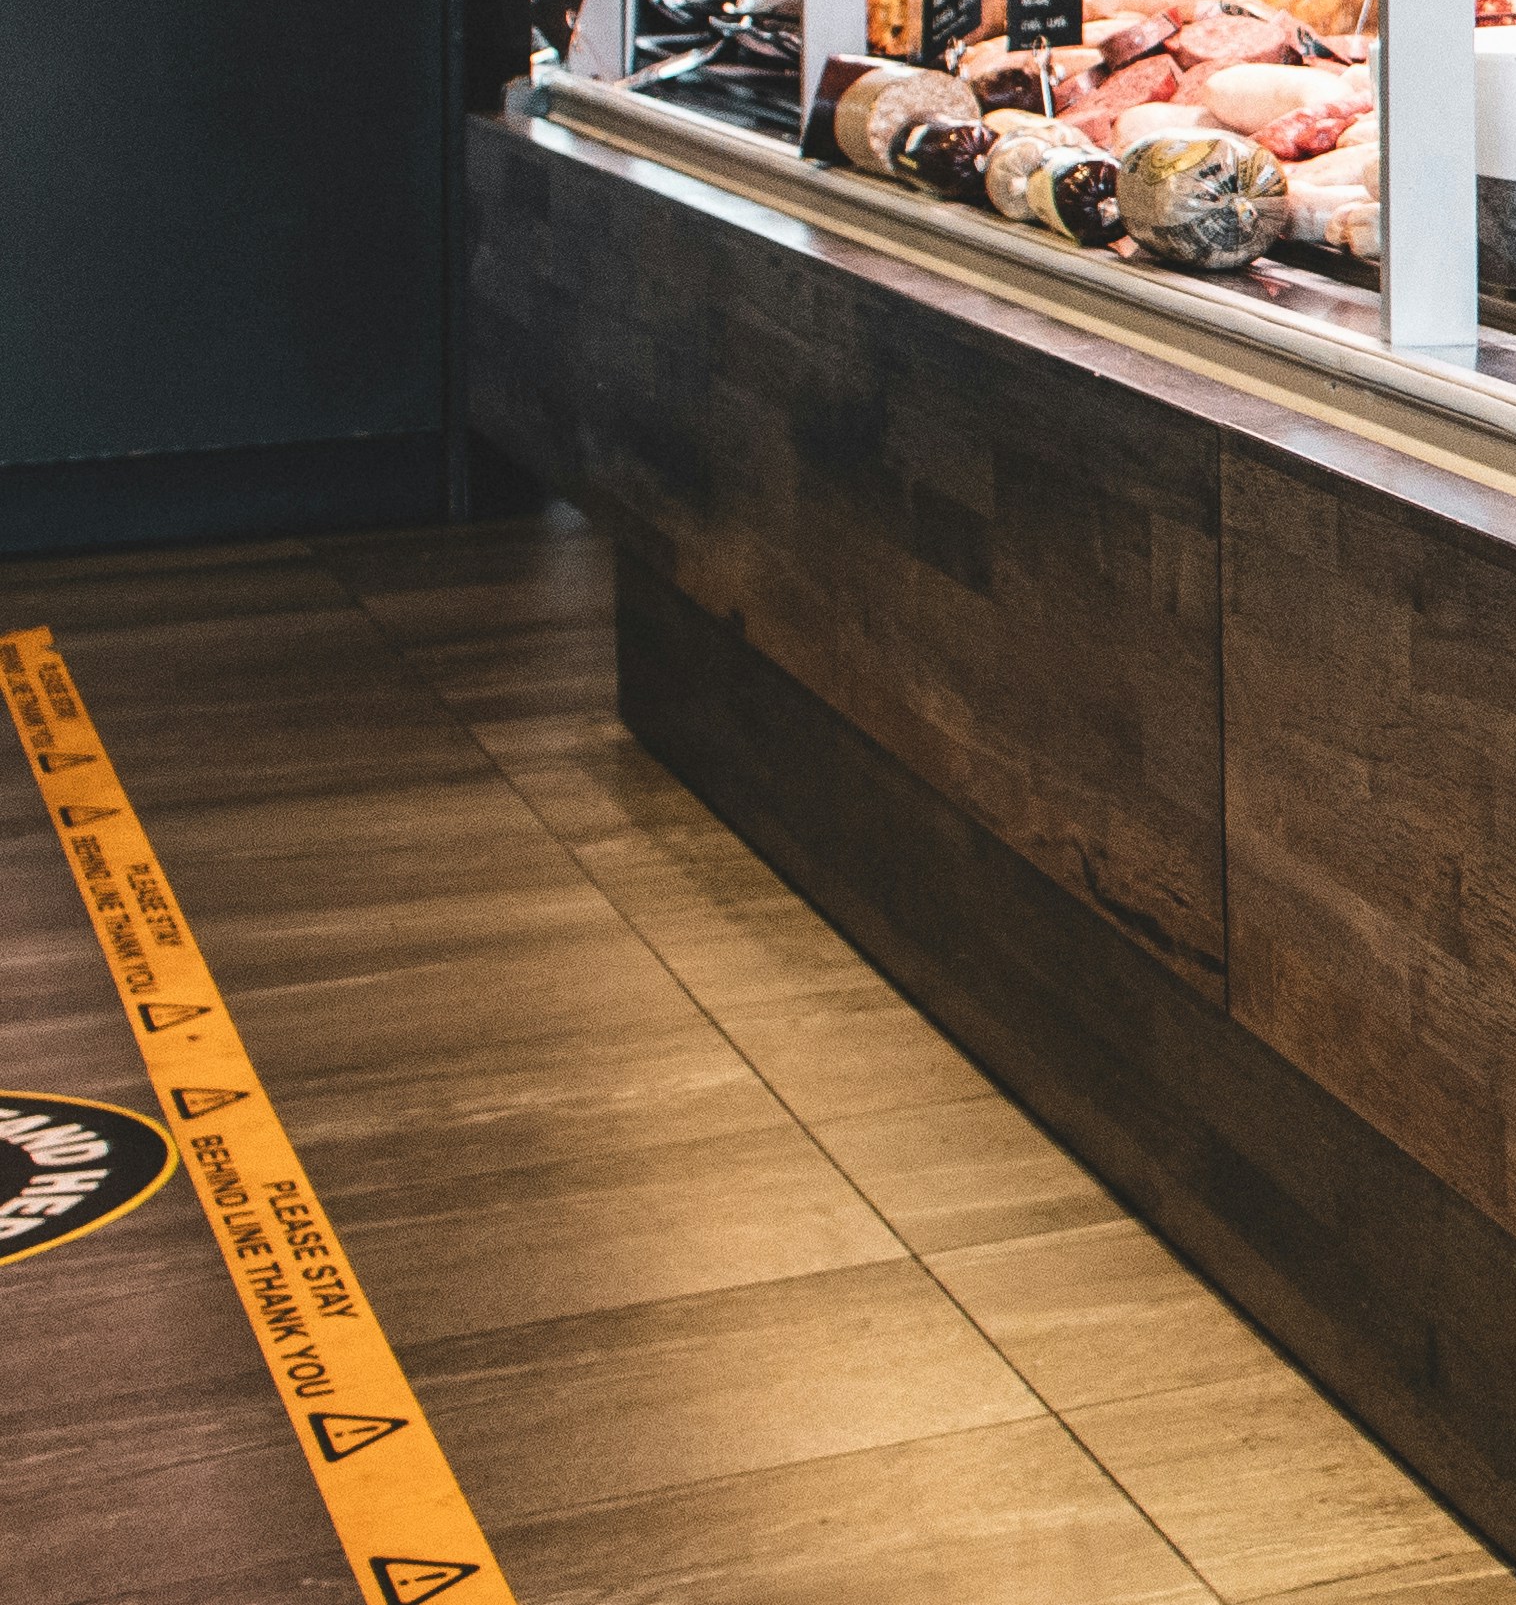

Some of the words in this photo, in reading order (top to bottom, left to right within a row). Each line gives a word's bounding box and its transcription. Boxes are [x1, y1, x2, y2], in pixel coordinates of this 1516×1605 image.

[190, 1133, 250, 1209] BEHIND
[221, 1209, 274, 1260] LINE
[261, 1179, 331, 1261] PLEASE
[301, 1263, 361, 1321] STAY
[245, 1260, 311, 1345] THANK
[281, 1344, 336, 1400] YOU
